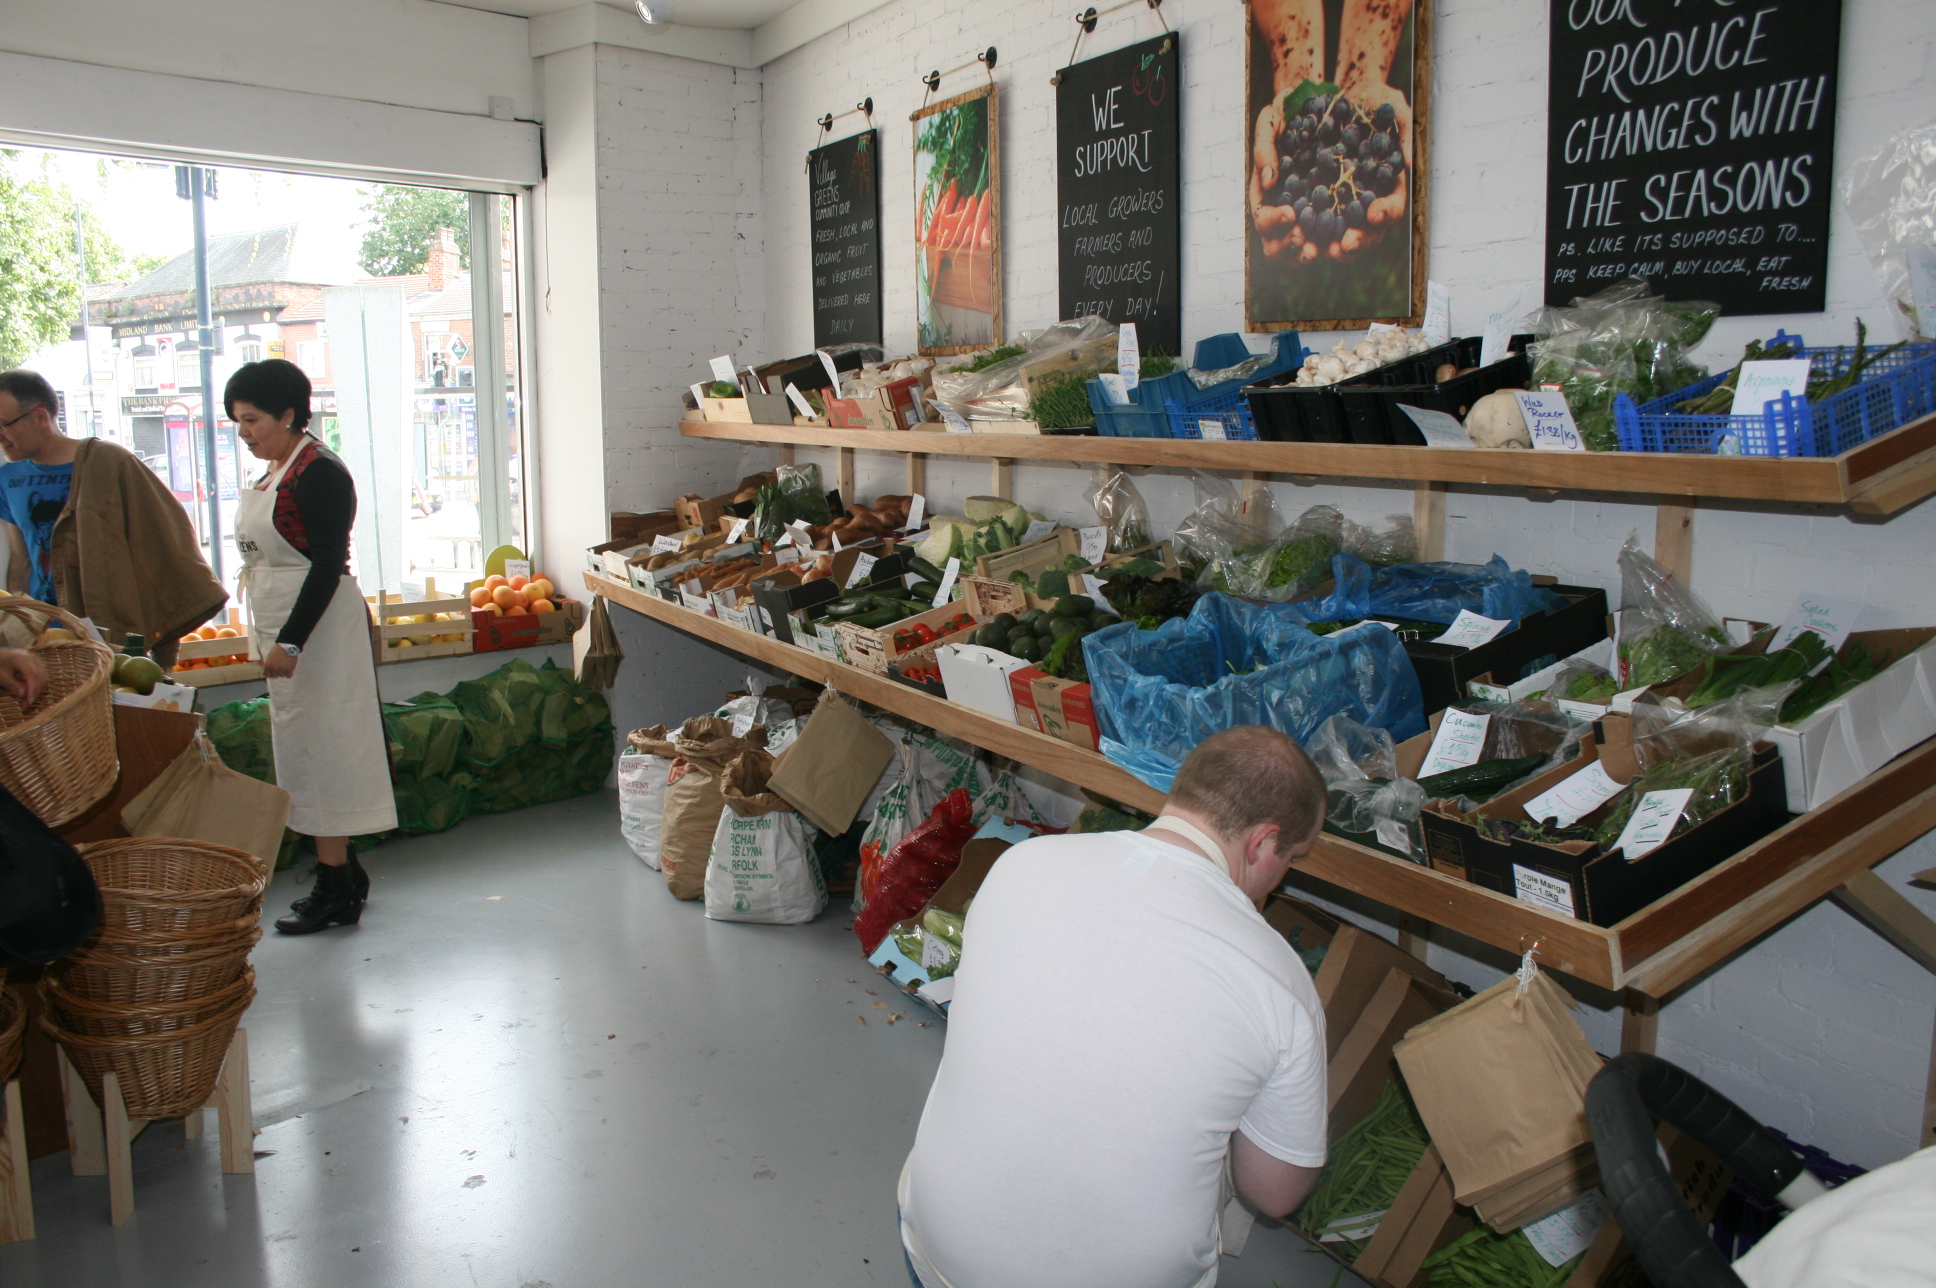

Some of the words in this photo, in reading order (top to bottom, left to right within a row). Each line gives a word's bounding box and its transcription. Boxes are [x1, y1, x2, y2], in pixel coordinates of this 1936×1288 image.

[1577, 9, 1779, 103] PRODUCE
[1092, 86, 1125, 132] WE
[1564, 96, 1719, 164] CHANGES
[1729, 75, 1826, 140] WITH
[1075, 130, 1153, 177] SUPPORT
[815, 153, 837, 188] Village
[814, 185, 839, 207] GREENS
[1564, 179, 1628, 229] THE
[1639, 155, 1813, 223] SEASONS
[1063, 203, 1098, 228] LOCAL
[1108, 189, 1164, 220] GROWERS
[839, 222, 857, 236] LOCAL
[860, 218, 874, 232] AND
[1557, 242, 1581, 257] PS.
[1587, 237, 1624, 255] LIKE
[1634, 233, 1663, 253] ITS
[1669, 226, 1765, 249] SUPPOSED
[815, 252, 842, 267] ORGANIC
[847, 243, 868, 259] FRUIT
[1074, 232, 1122, 257] FARMERS
[1128, 227, 1153, 248] AND
[816, 275, 827, 288] AND
[831, 265, 873, 284] VEGETABLES
[1084, 260, 1152, 290] PRODUCERS
[1553, 268, 1576, 285] PPS
[1587, 260, 1625, 279] KEEP
[1628, 259, 1670, 280] CALM,
[1672, 258, 1701, 276] BUY
[1703, 259, 1752, 277] LOCAL,
[1758, 256, 1792, 272] EAT
[1759, 276, 1813, 292] FRESH
[818, 295, 849, 310] DELIVERED
[854, 293, 871, 306] HERE
[1074, 298, 1114, 319] EVERY
[1126, 270, 1165, 316] DAY!
[119, 326, 148, 336] MIDLAND
[154, 323, 173, 333] BANK
[830, 318, 854, 335] DAILY
[1515, 878, 1532, 891] Tout
[1538, 887, 1559, 902] 1.5kg
[1516, 870, 1538, 884] rple
[1540, 879, 1567, 895] Mange
